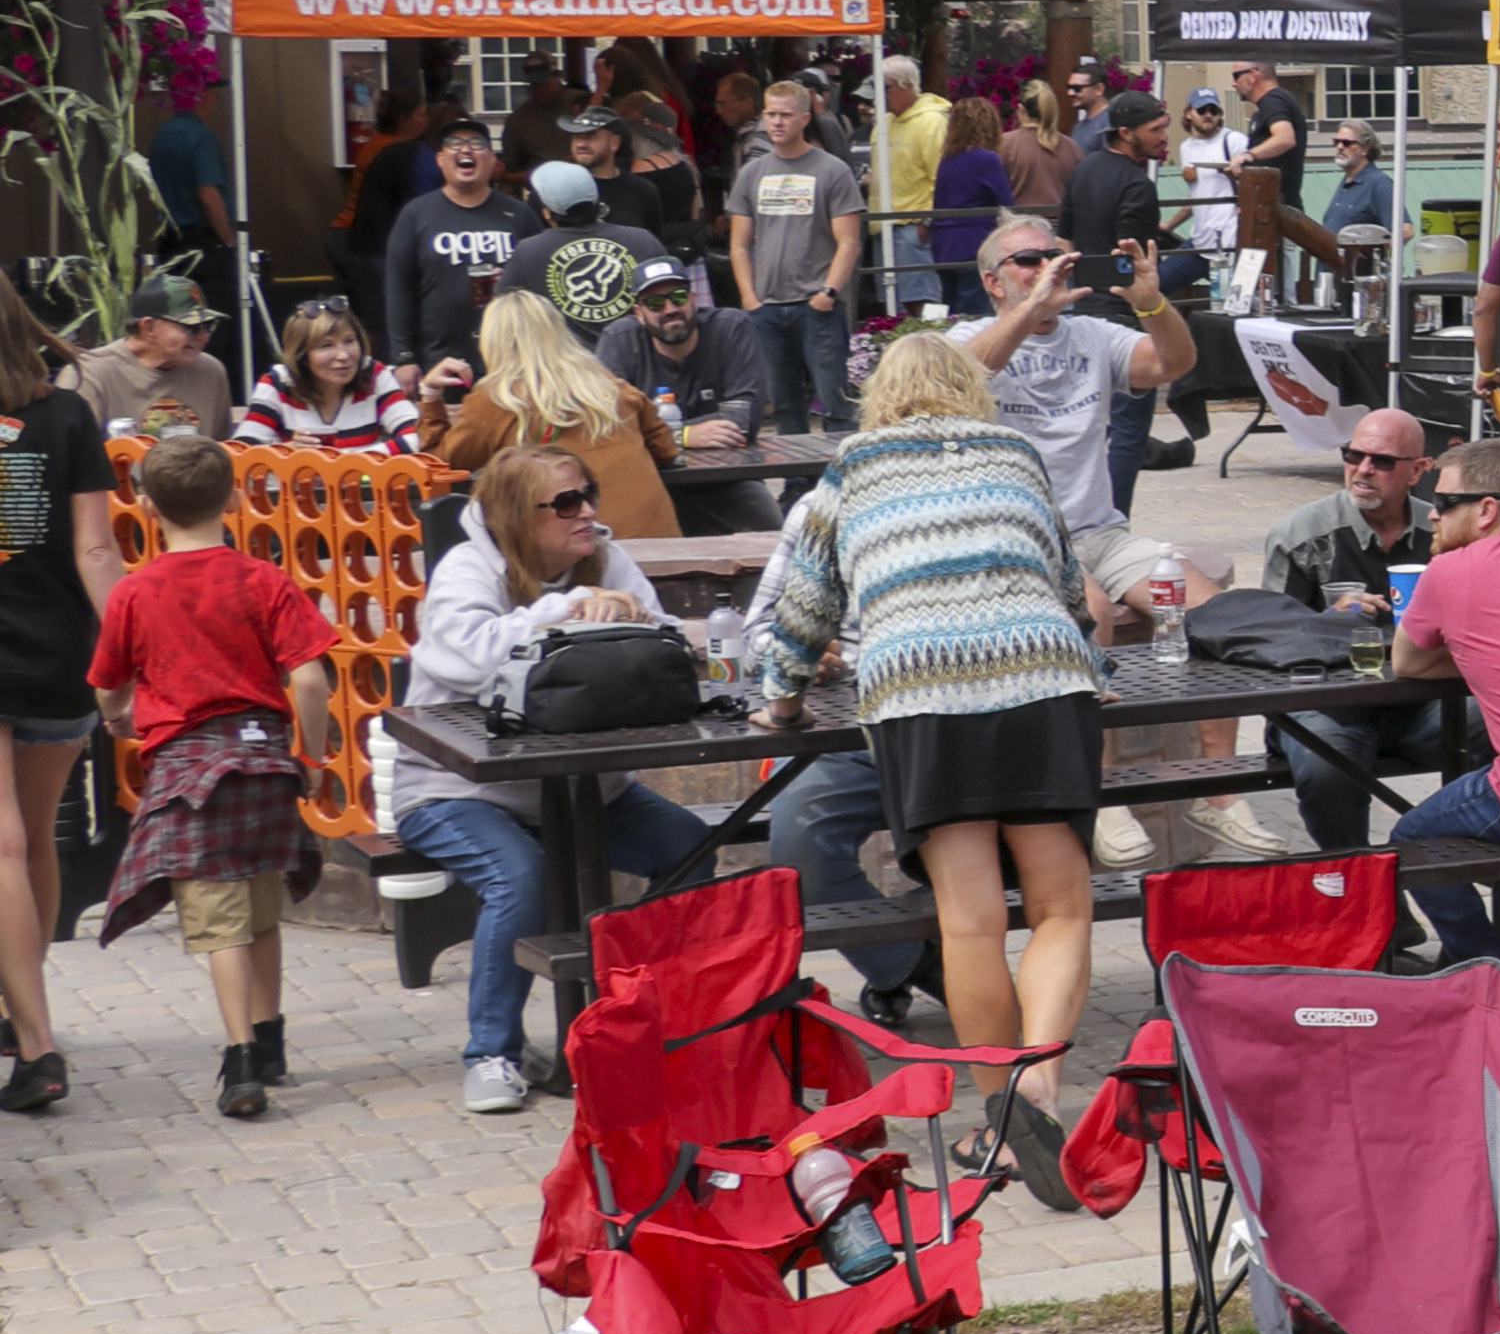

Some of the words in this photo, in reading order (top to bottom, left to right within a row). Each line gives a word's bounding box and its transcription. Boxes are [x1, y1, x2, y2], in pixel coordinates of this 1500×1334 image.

[1181, 11, 1237, 39] DENTED
[1238, 10, 1285, 39] BRICK
[1286, 11, 1371, 41] DISTILLERY
[558, 242, 587, 261] FOX
[570, 299, 629, 320] RACING
